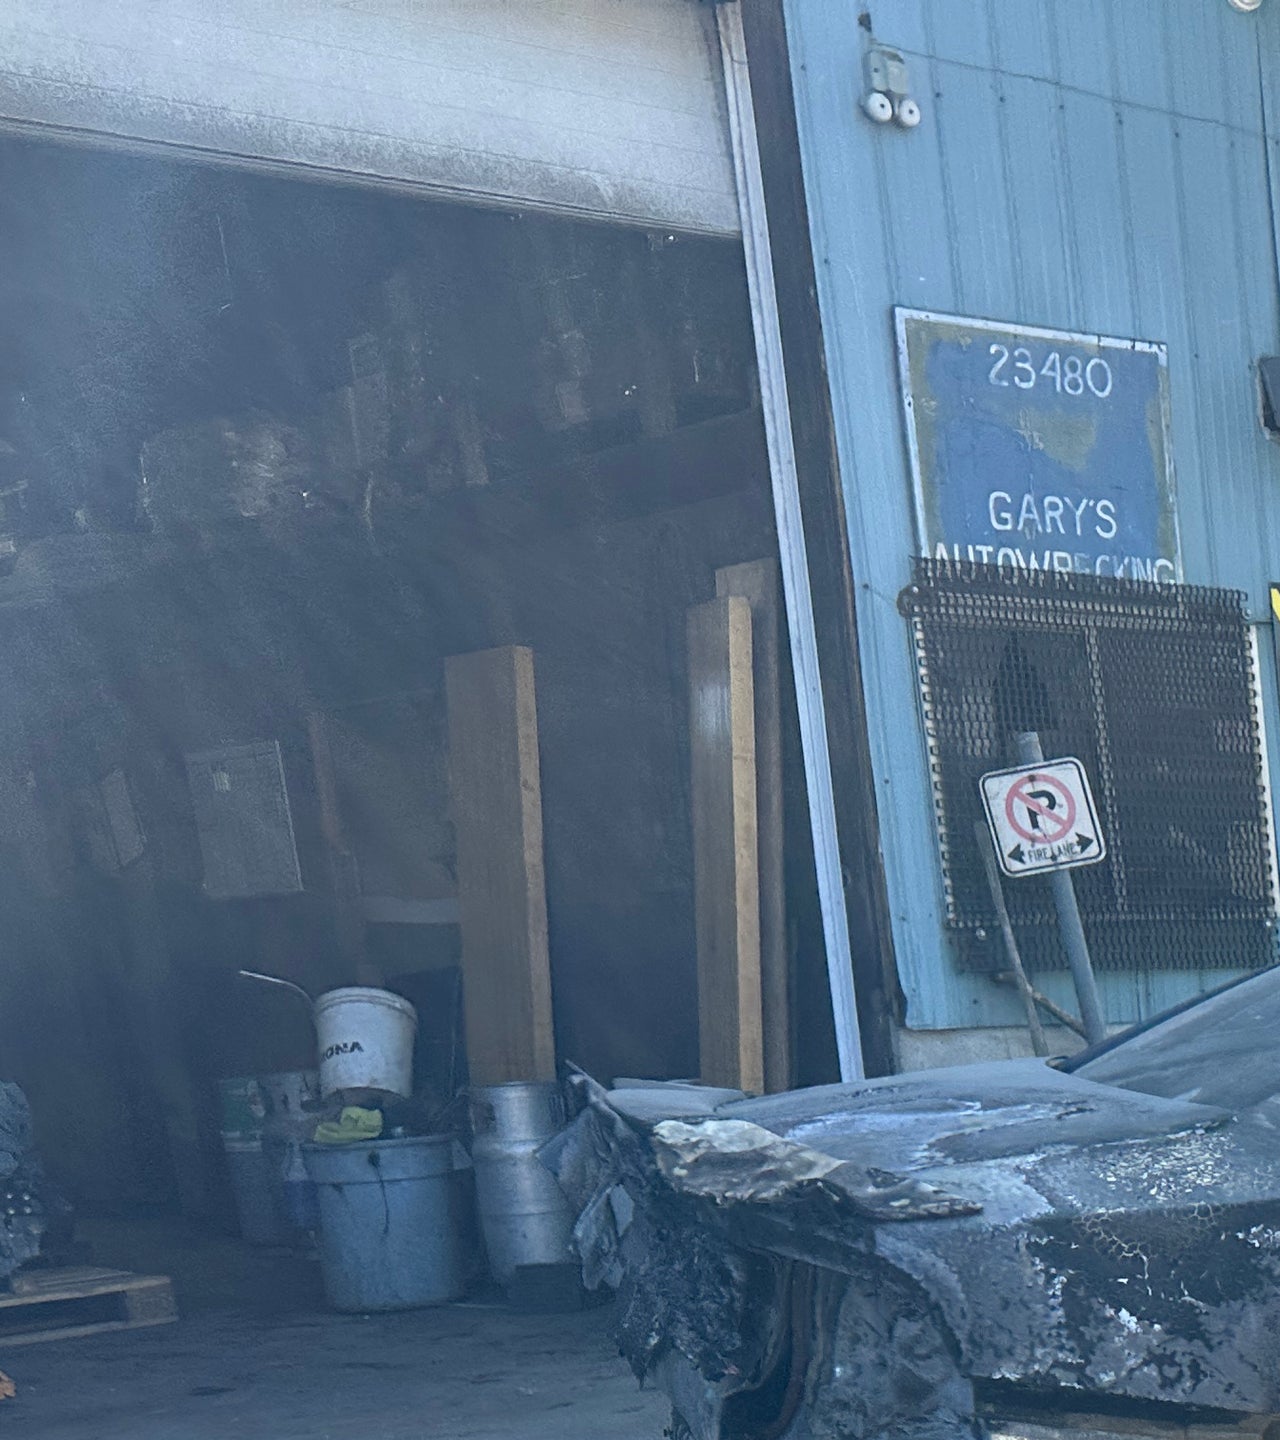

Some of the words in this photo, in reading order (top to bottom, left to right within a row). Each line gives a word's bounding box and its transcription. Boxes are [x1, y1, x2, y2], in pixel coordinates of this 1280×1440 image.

[989, 344, 1113, 398] 23480
[989, 490, 1118, 539] GARY'S
[1028, 847, 1049, 863] FIRE
